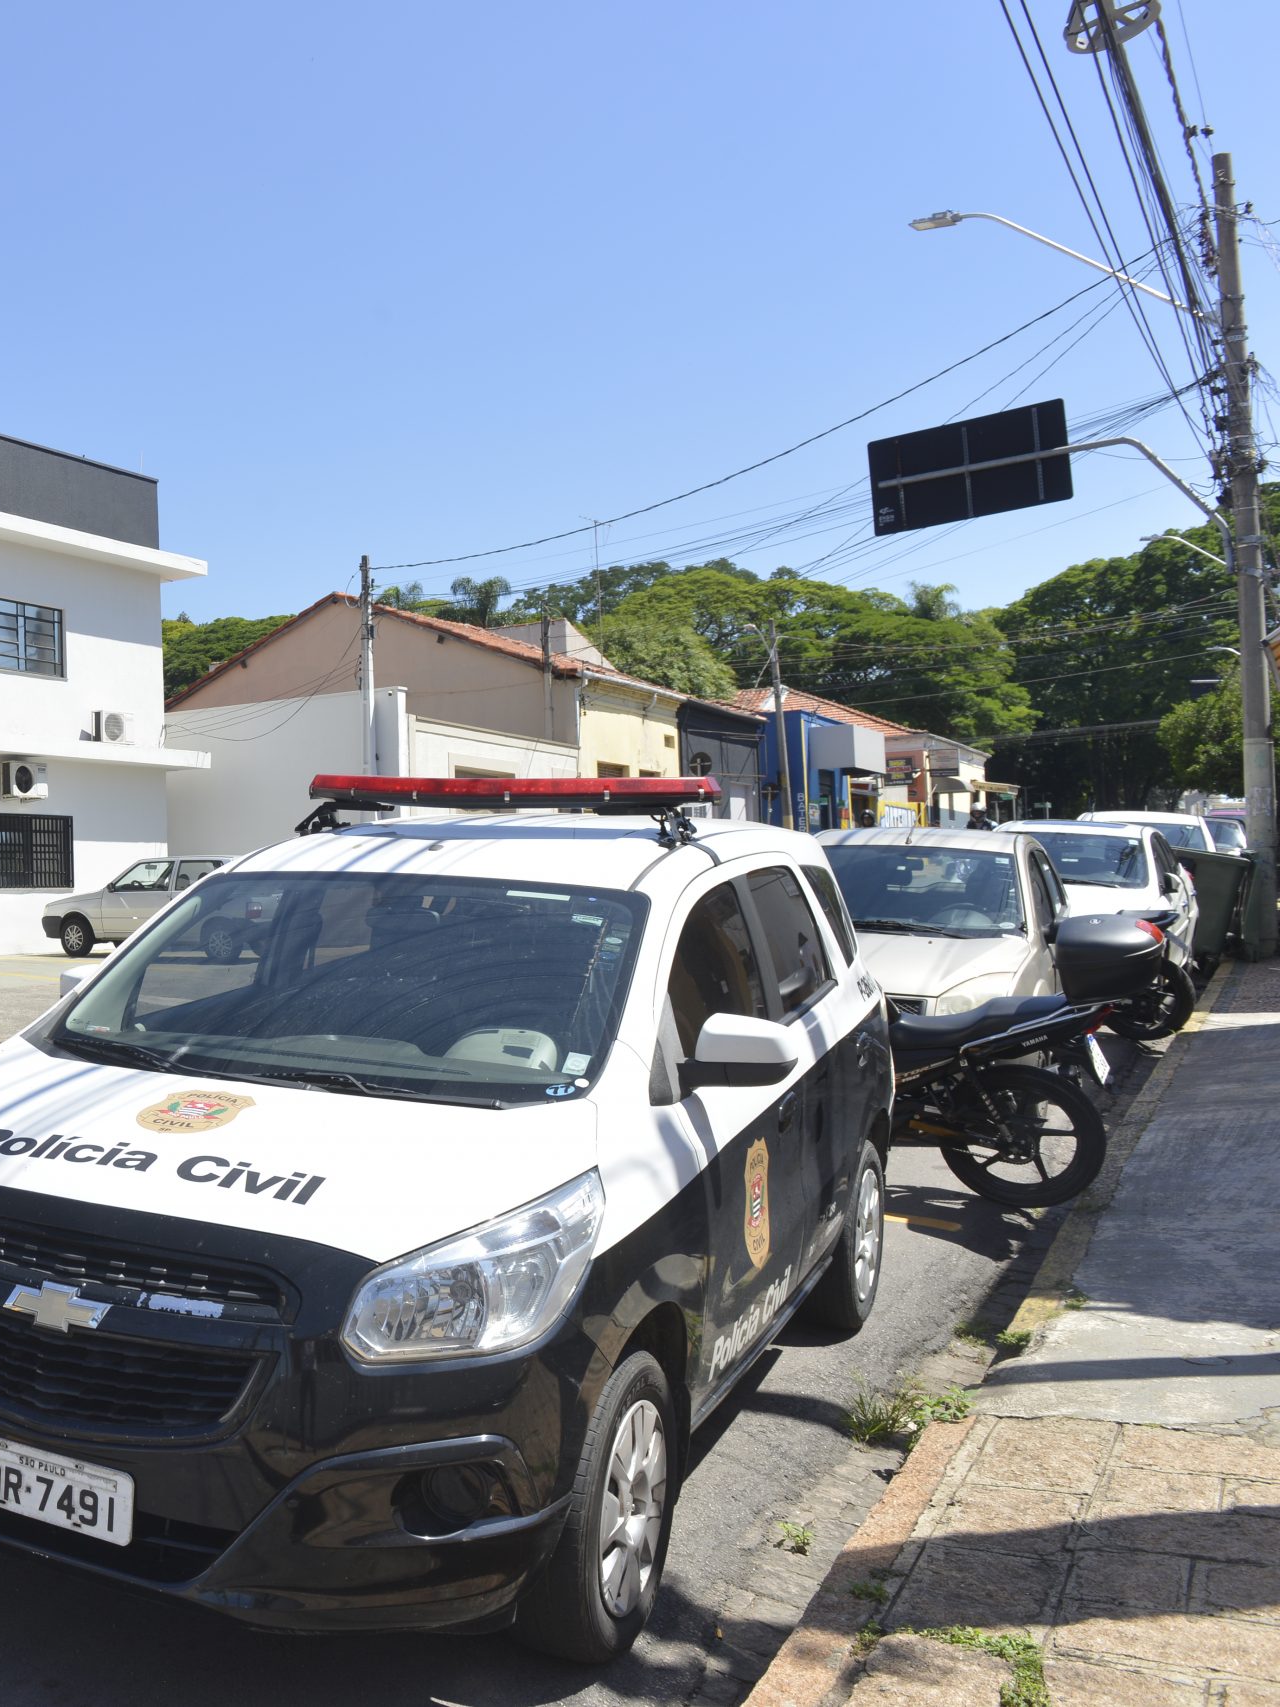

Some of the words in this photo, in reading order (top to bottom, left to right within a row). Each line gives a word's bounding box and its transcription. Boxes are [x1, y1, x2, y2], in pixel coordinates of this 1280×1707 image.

[1021, 1034, 1048, 1047] YAMAHA
[187, 1092, 238, 1104] POLÍCIA
[152, 1118, 194, 1128] CIVIL
[176, 1155, 327, 1205] Civil
[708, 1304, 760, 1383] Polícia
[762, 1264, 792, 1324] Civil
[38, 1461, 66, 1477] PAULO
